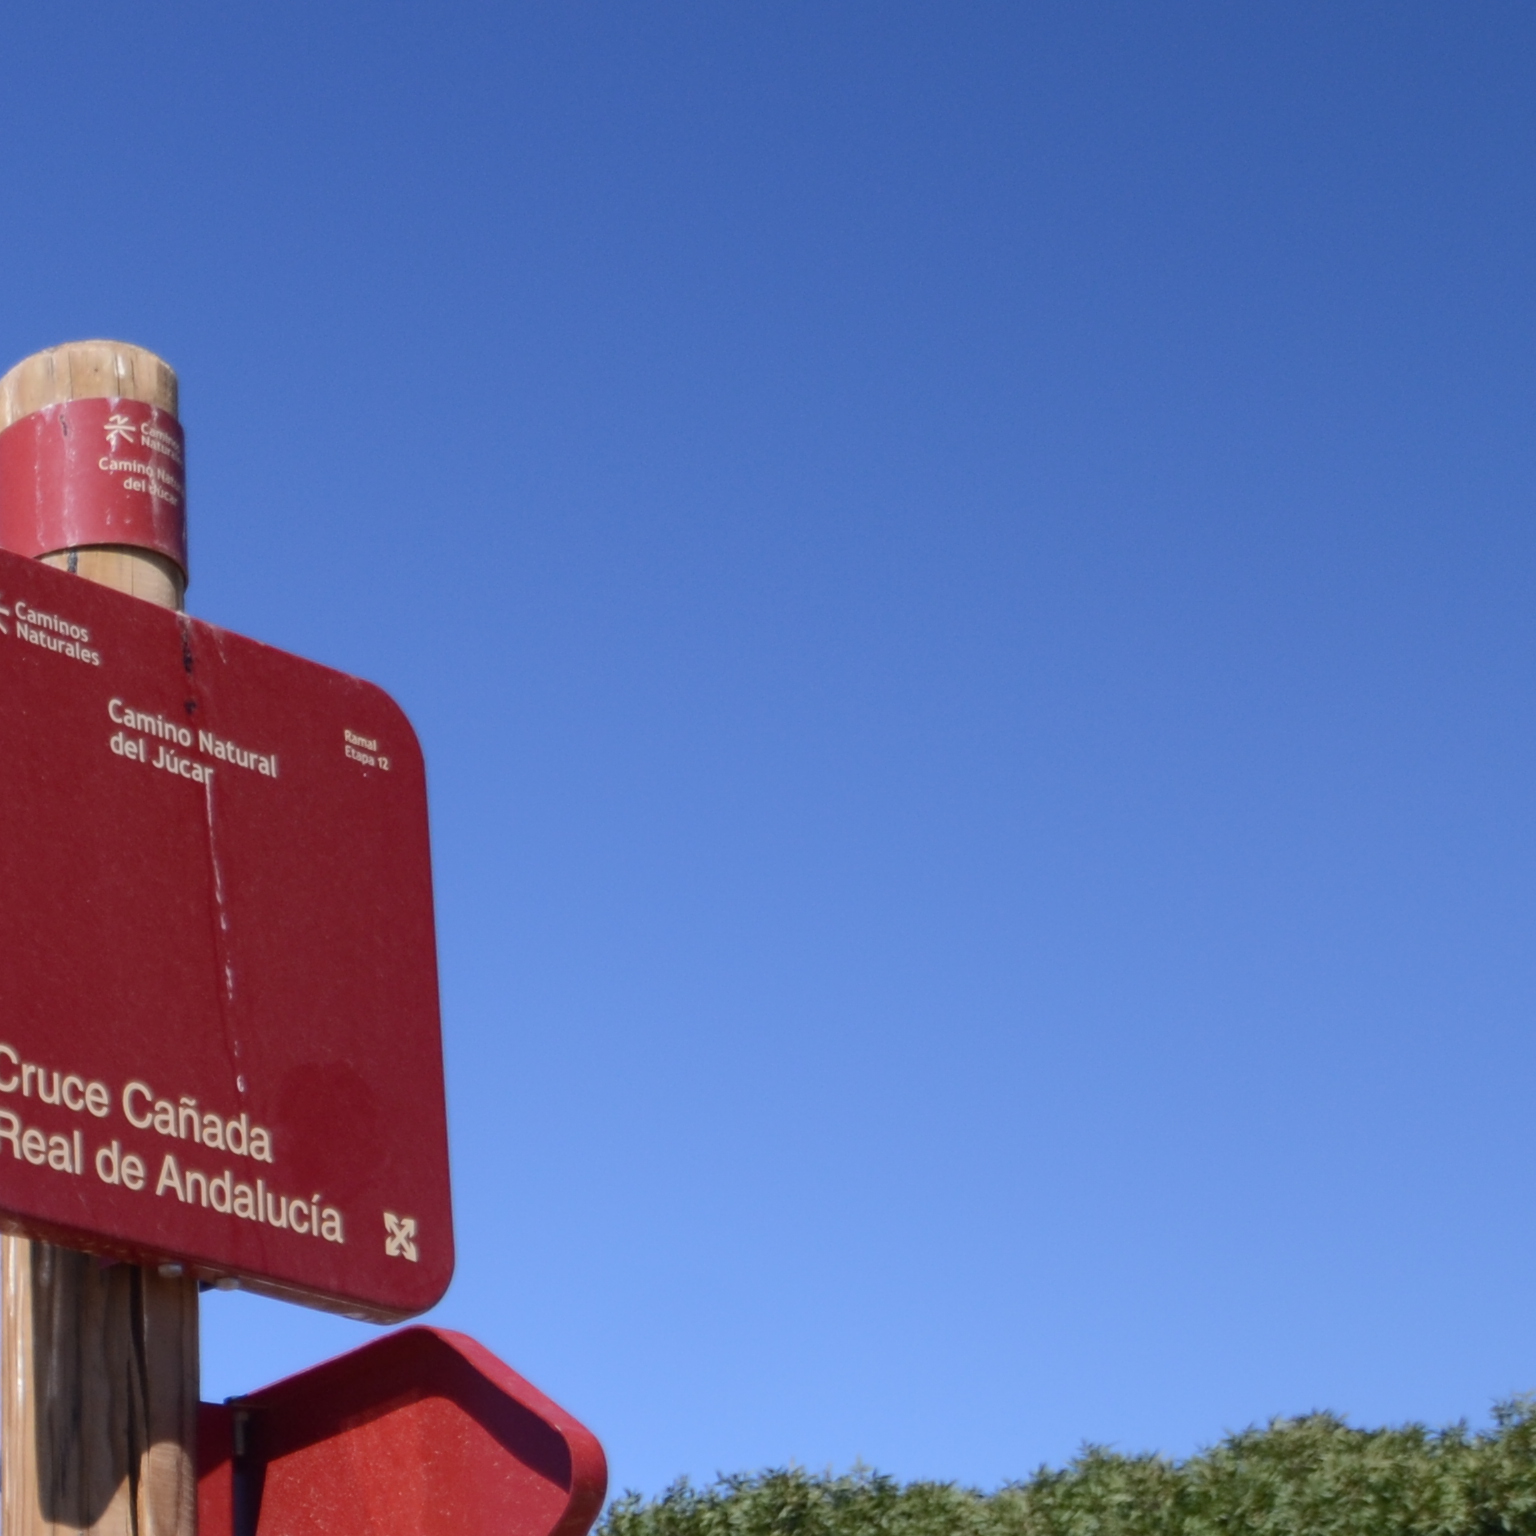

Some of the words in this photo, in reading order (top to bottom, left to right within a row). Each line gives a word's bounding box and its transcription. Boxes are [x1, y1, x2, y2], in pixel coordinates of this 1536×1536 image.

[98, 456, 154, 478] Camino
[123, 477, 146, 492] del
[14, 601, 89, 643] Caminos
[16, 620, 101, 666] Naturales
[107, 698, 193, 748] Camino
[198, 728, 278, 779] Natural
[109, 731, 146, 763] del
[151, 745, 214, 785] Júcar
[344, 729, 377, 752] Ramal
[344, 744, 375, 767] Etapa
[377, 756, 389, 771] 12
[122, 1081, 274, 1164] Cañada
[95, 1140, 146, 1191] de
[155, 1154, 344, 1245] Andalucía
